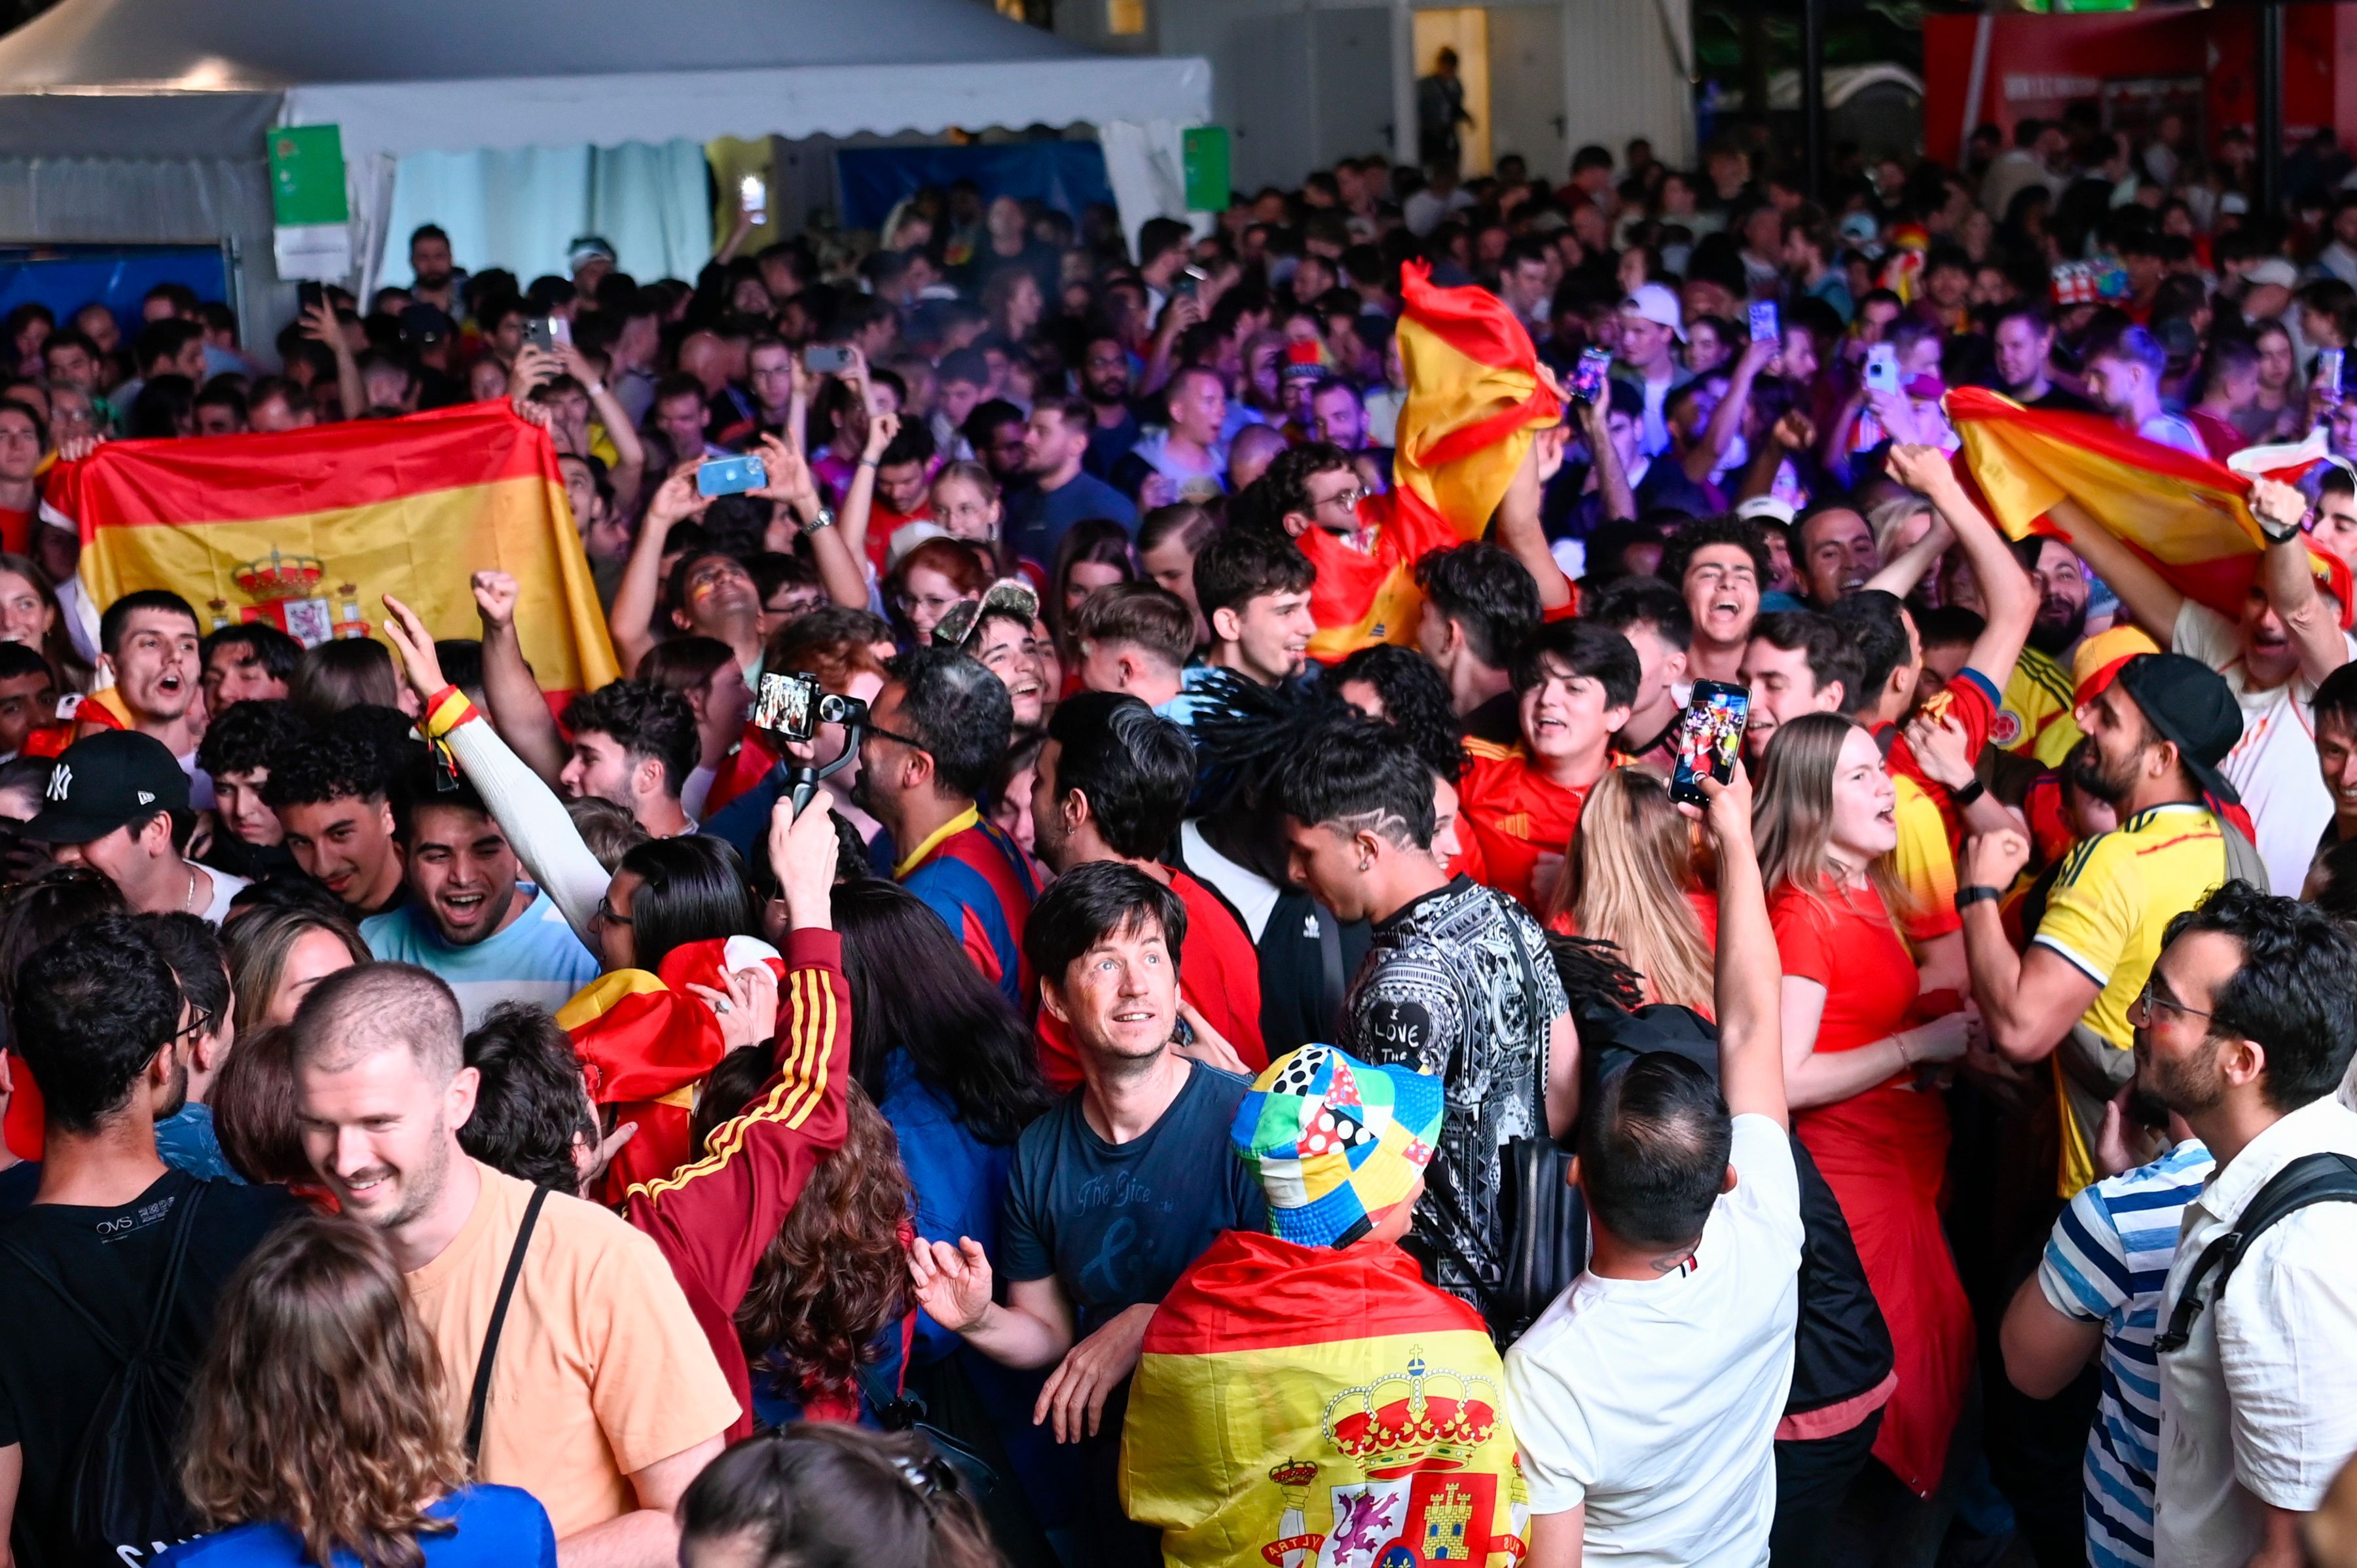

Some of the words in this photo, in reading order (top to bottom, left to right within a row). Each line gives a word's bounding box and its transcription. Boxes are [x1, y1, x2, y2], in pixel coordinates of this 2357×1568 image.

[1390, 1009, 1399, 1021] I
[1375, 1022, 1419, 1048] LOVE
[96, 1216, 133, 1235] OVS
